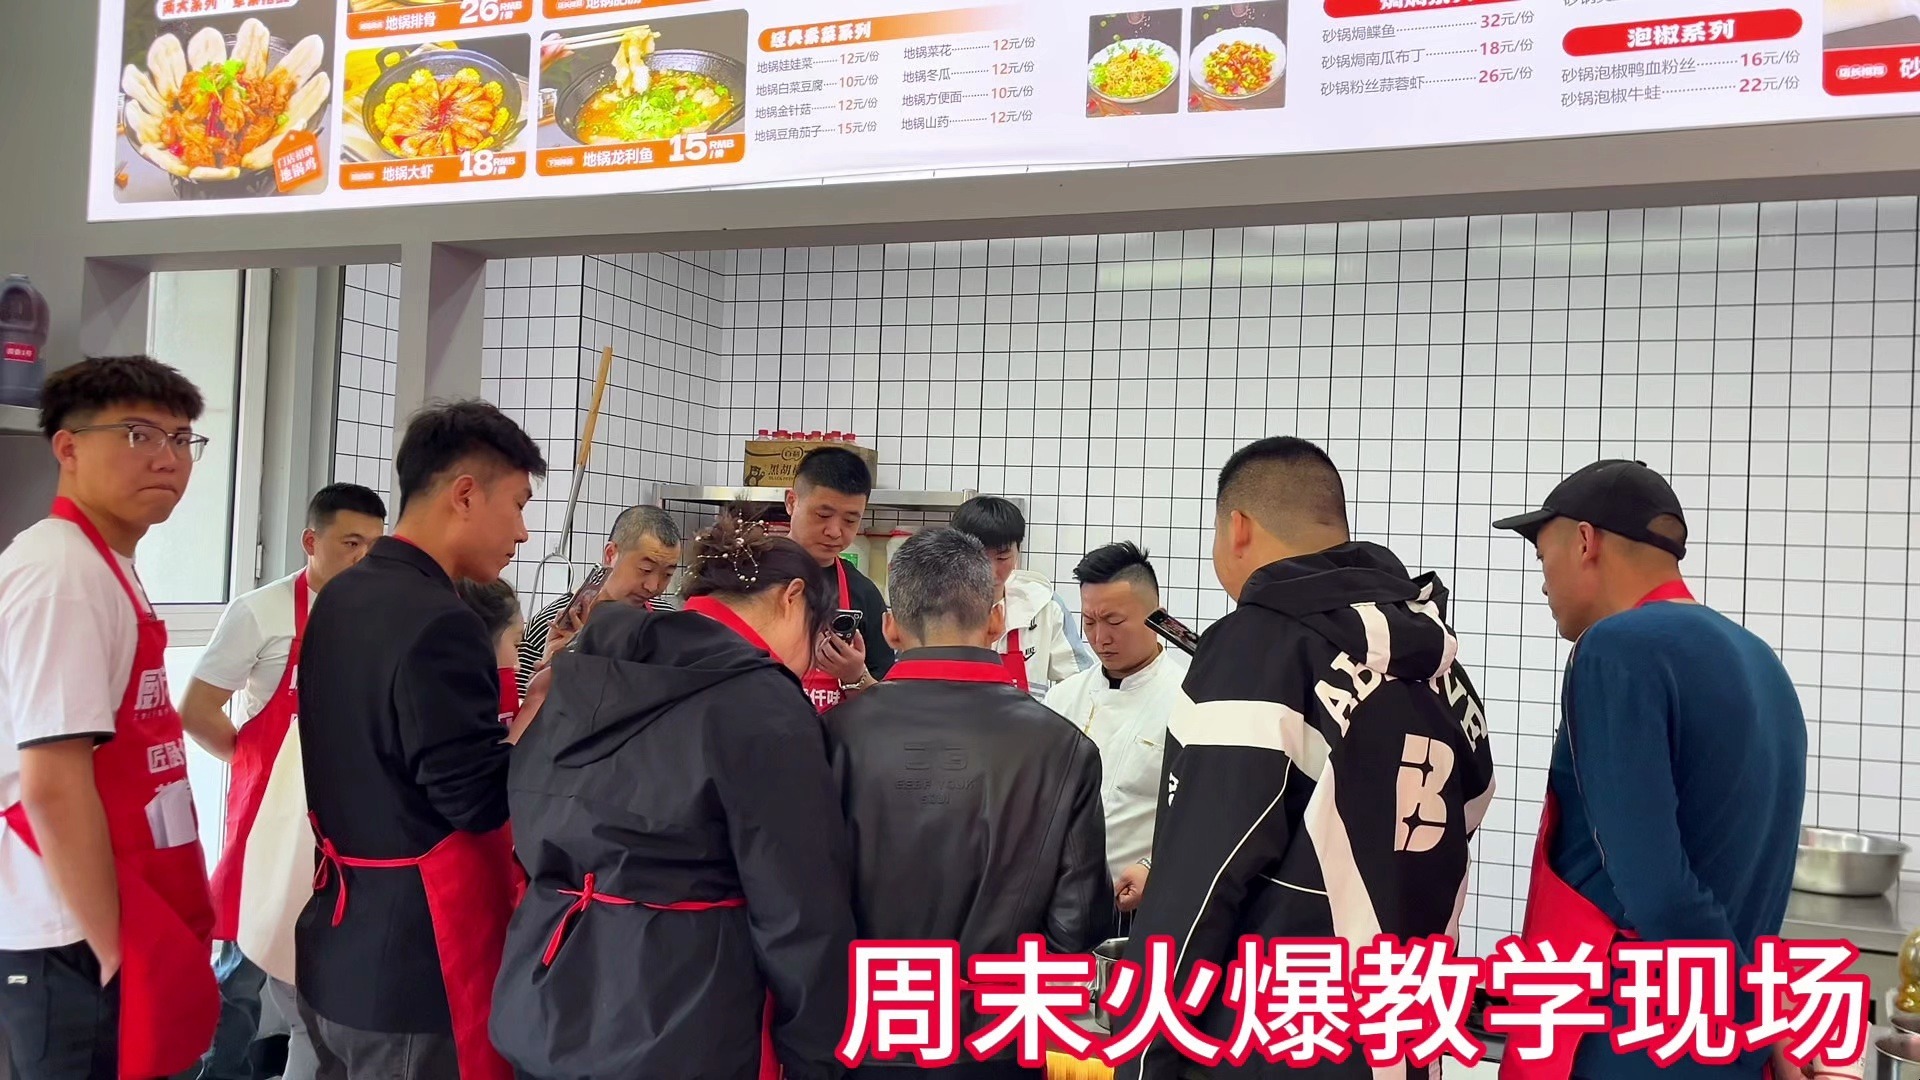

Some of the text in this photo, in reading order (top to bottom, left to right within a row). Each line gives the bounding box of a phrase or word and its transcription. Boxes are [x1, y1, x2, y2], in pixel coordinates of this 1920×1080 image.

[385, 11, 436, 31] 地锅排骨
[459, 0, 499, 24] 26
[1480, 10, 1535, 29] 32元/份
[1627, 19, 1736, 48] 泡椒系列
[903, 36, 1036, 60] 地锅菜花 12元/份
[1321, 38, 1534, 70] 砂锅焗南瓜布丁 18元/份
[757, 50, 879, 73] 地锅娃娃菜 12元/份
[902, 60, 1035, 83] 地锅冬瓜 12元/份
[1561, 50, 1800, 83] 砂锅泡椒鸭血粉丝 16元/份
[756, 74, 879, 97] 地锅白菜豆腐 10元/份
[1320, 66, 1533, 97] 砂锅粉丝蒜蓉虾 26元/份
[1561, 76, 1800, 108] 砂锅泡椒牛蛙 22元/份
[902, 85, 1034, 107] 地锅方便面 10元/份
[755, 97, 878, 119] 地锅金针菇 12元/份
[754, 120, 878, 142] 地锅豆角茄子 15元/份
[901, 109, 1033, 131] 地锅山药 12元/份
[669, 132, 708, 162] 15
[709, 139, 735, 149] RMB
[459, 149, 493, 177] 18
[582, 147, 654, 167] 地锅龙利鱼
[280, 156, 317, 182] 地锅鸡
[382, 164, 434, 182] 地锅大虾
[803, 688, 840, 706] 仟味
